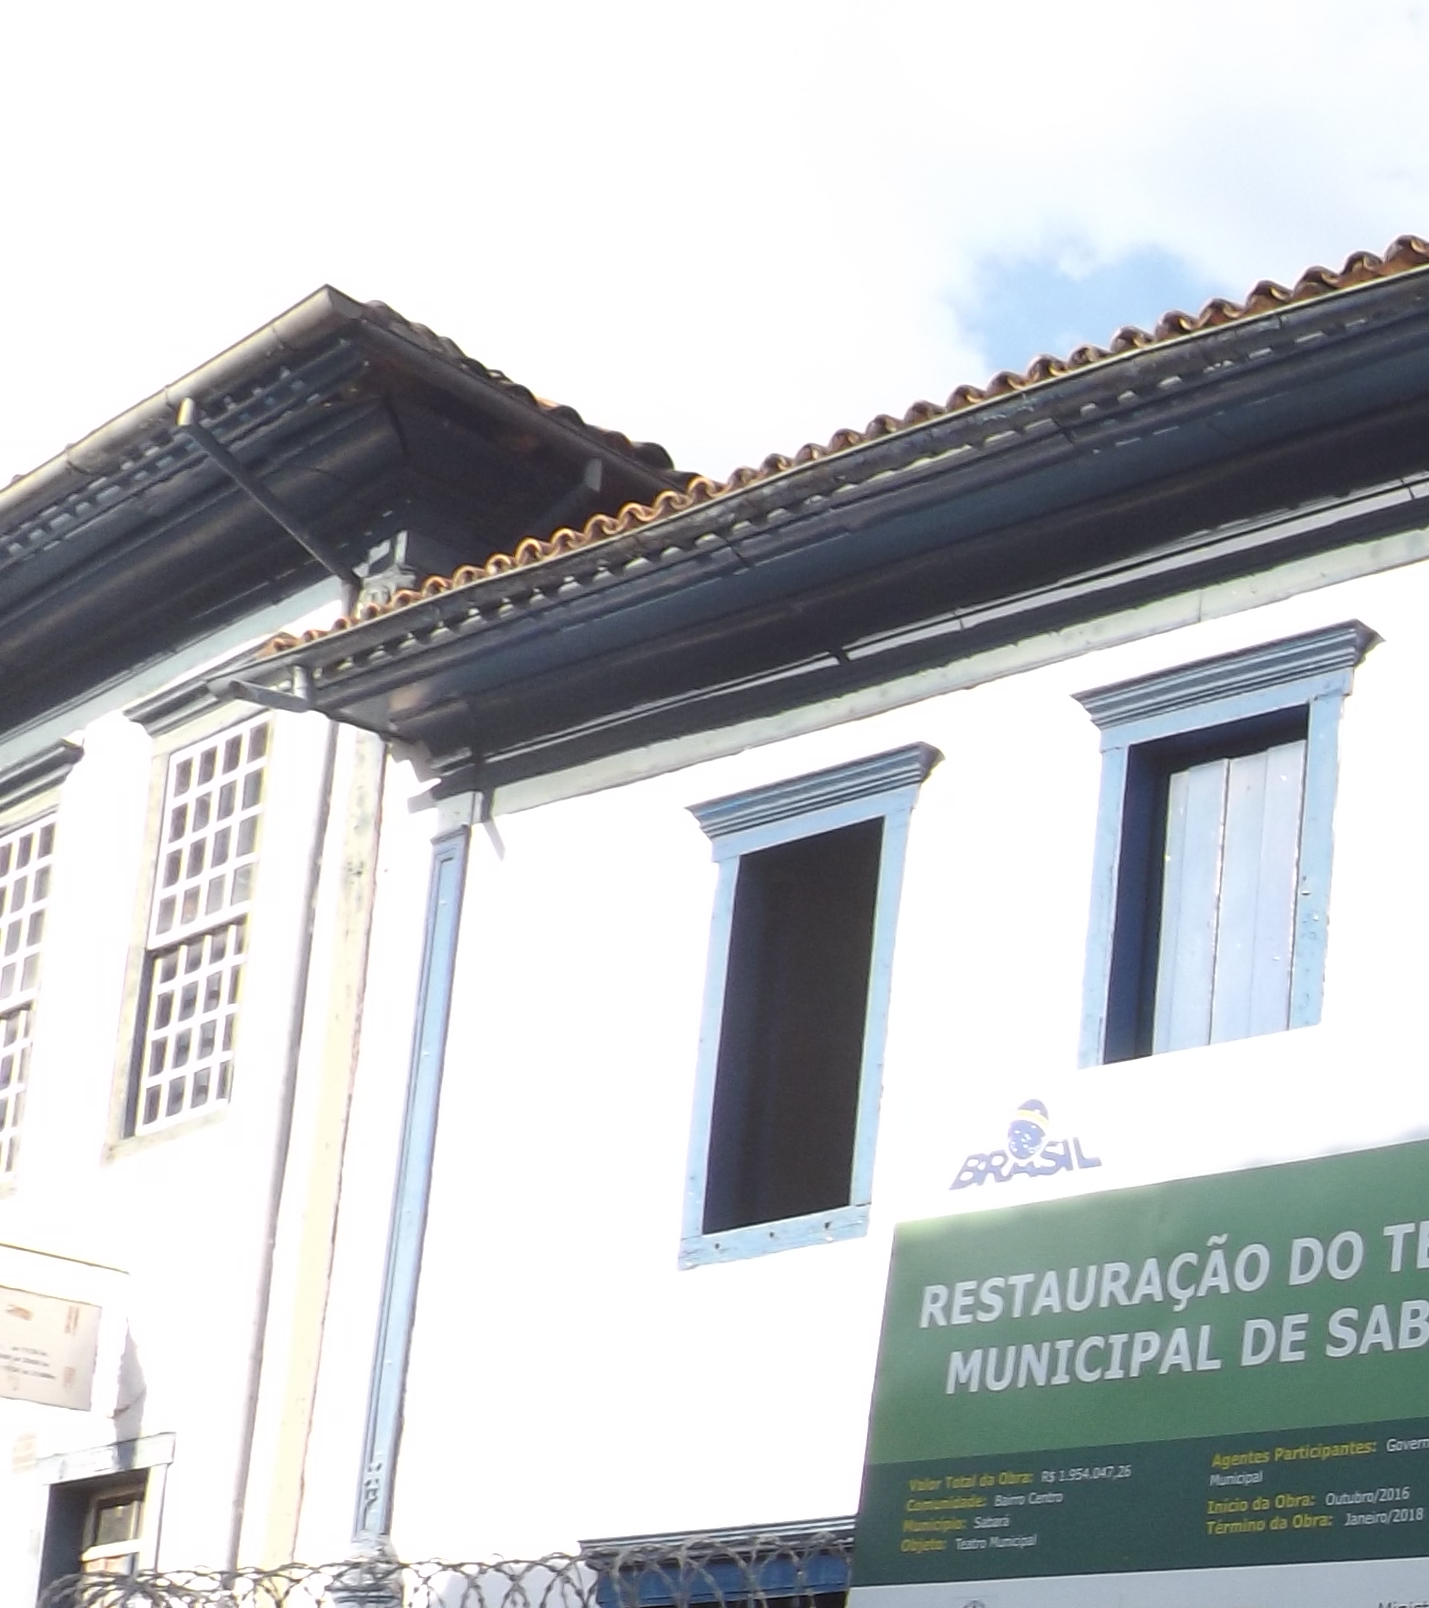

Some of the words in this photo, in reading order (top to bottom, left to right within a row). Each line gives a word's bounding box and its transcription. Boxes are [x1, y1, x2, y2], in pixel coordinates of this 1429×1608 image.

[948, 1136, 1103, 1191] BRASIL
[919, 1233, 1271, 1330] RESTAURAÇÃO
[1288, 1230, 1365, 1287] DO
[945, 1325, 1222, 1395] MUNICIPAL
[1240, 1313, 1309, 1367] DE
[1210, 1450, 1271, 1470] Agentes
[1274, 1439, 1378, 1463] Participantes:
[1041, 1470, 1056, 1483] R$
[1209, 1470, 1265, 1488] Municipal
[1028, 1491, 1064, 1505] Centro
[1252, 1495, 1271, 1511] da
[1275, 1492, 1317, 1509] Obra:
[1324, 1486, 1411, 1507] Outubro/2016
[973, 1514, 1011, 1530] Sabará
[1206, 1517, 1266, 1536] Término
[1269, 1516, 1288, 1531] da
[1292, 1513, 1334, 1530] Obra:
[1343, 1507, 1425, 1528] Janeiro/2018
[955, 1537, 988, 1551] Teatro
